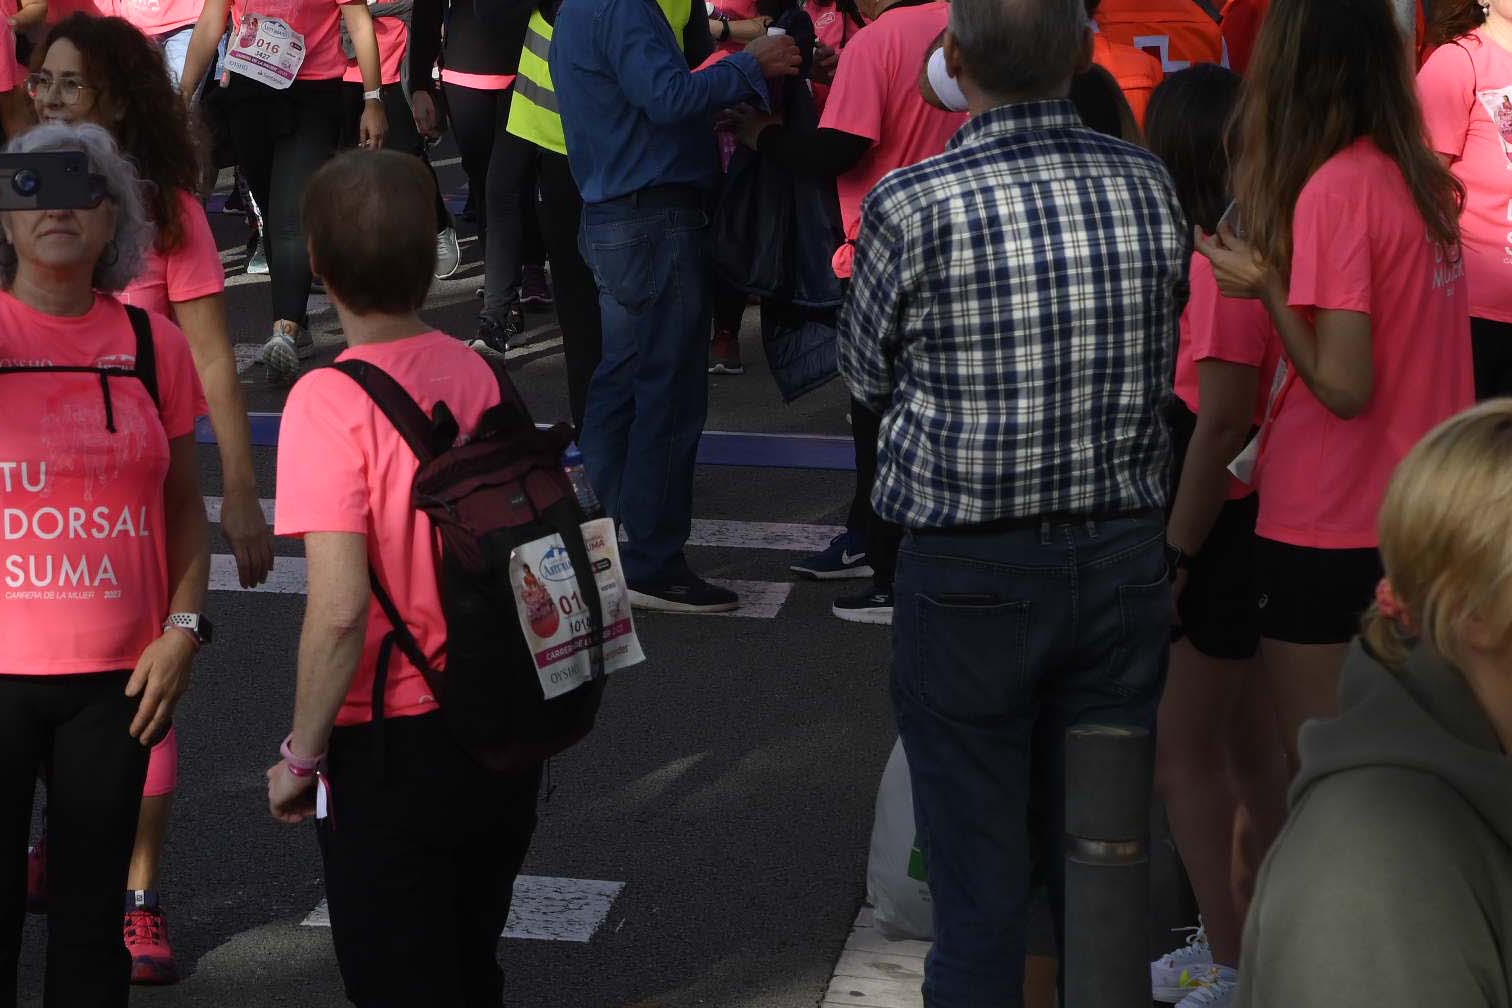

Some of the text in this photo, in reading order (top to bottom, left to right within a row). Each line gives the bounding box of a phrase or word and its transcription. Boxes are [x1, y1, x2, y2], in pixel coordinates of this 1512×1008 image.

[256, 39, 281, 55] 016
[4, 506, 150, 540] DORSAL
[5, 554, 118, 587] SUMA
